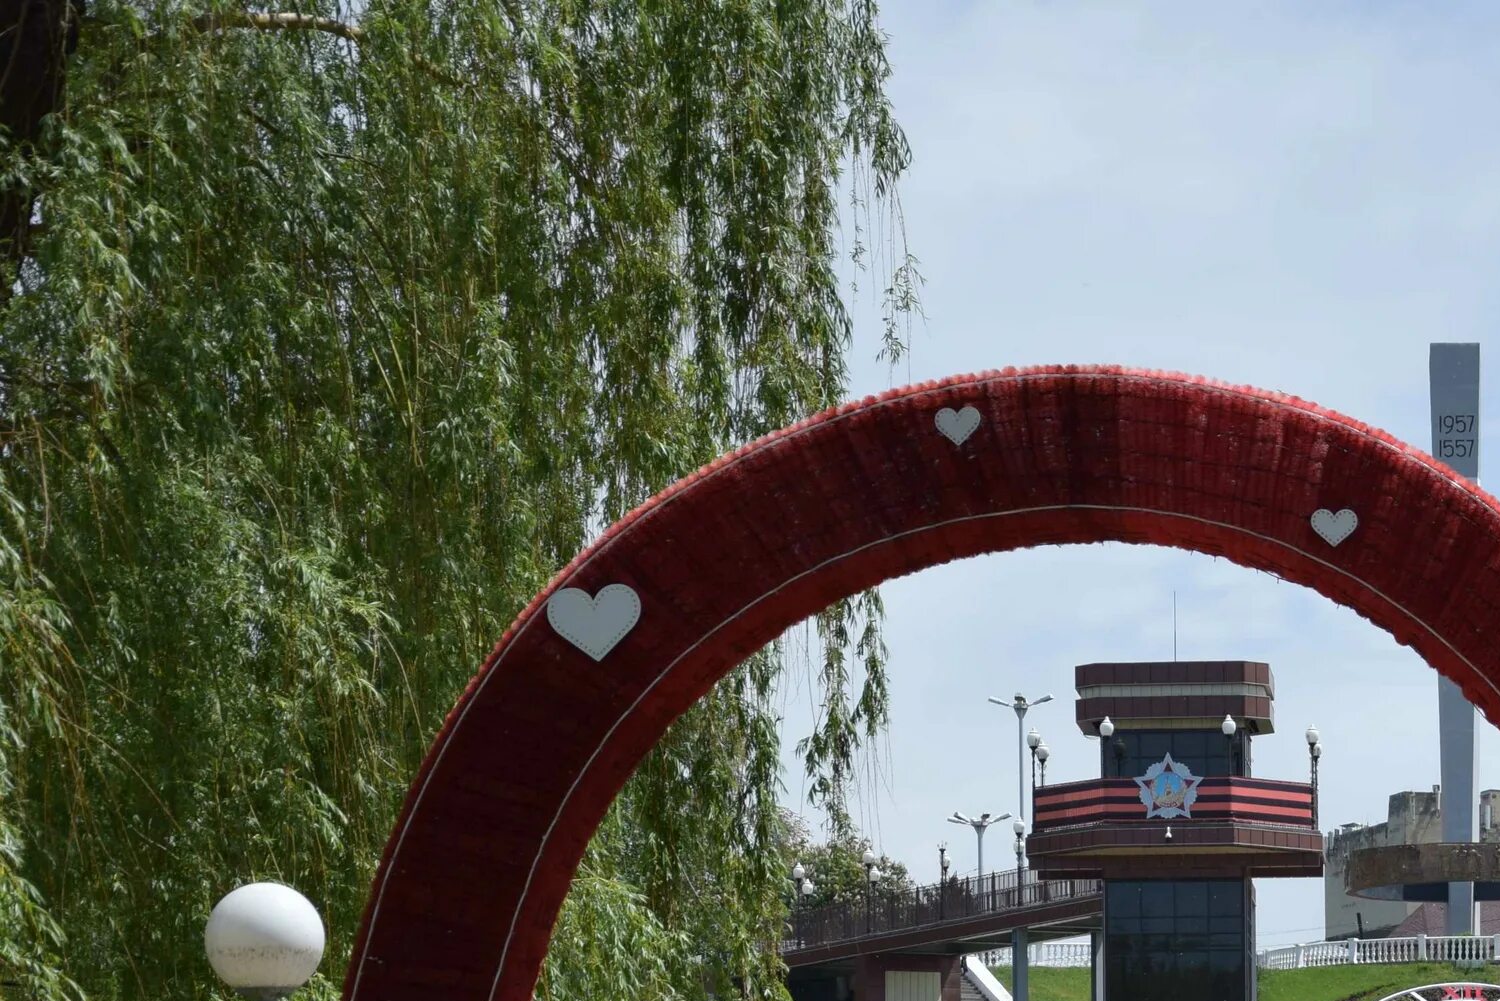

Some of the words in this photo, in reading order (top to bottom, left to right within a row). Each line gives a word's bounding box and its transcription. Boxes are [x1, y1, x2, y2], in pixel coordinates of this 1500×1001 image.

[1439, 415, 1475, 434] 1957
[1439, 439, 1475, 458] 1557
[1441, 985, 1484, 1000] XII
